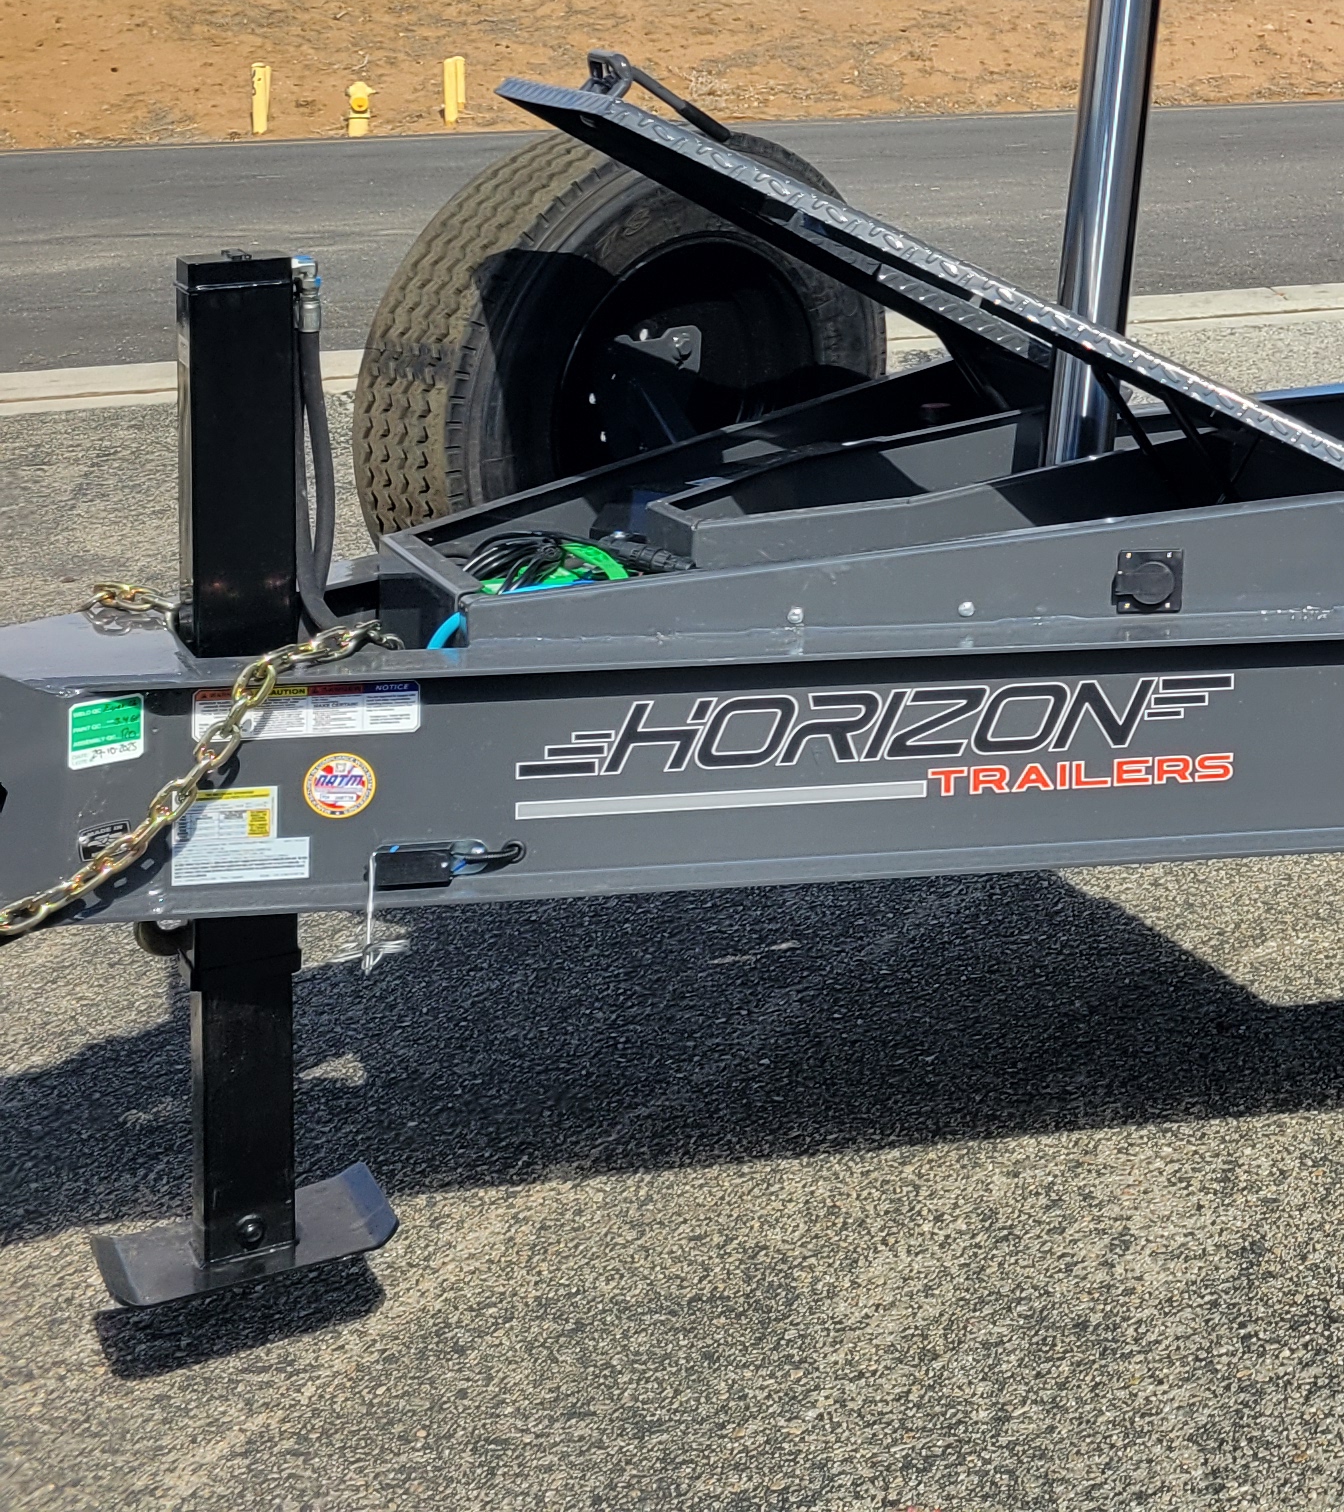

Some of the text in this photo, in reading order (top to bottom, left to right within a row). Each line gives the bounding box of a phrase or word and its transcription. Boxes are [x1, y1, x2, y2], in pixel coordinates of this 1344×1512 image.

[270, 688, 305, 696] AUTION
[375, 683, 410, 691] NOTICE
[601, 676, 1158, 775] HORIZON
[927, 753, 1236, 798] TRAILERS
